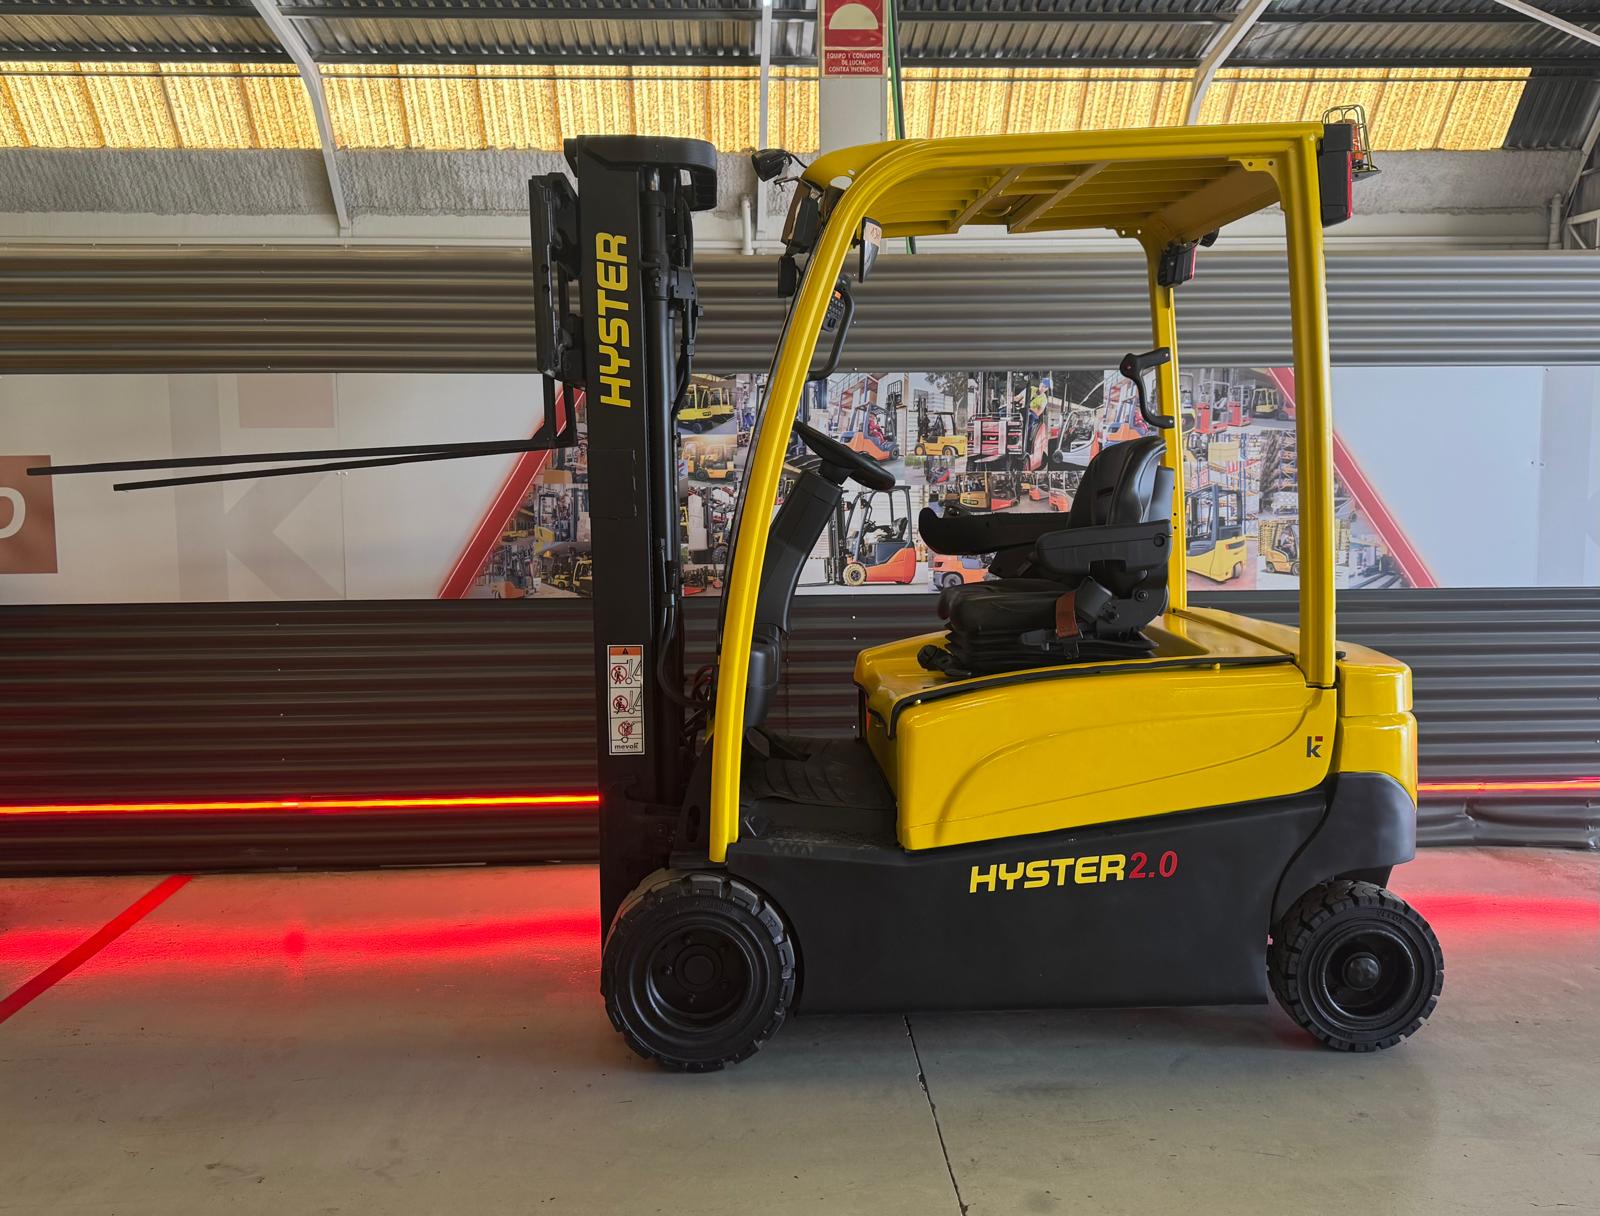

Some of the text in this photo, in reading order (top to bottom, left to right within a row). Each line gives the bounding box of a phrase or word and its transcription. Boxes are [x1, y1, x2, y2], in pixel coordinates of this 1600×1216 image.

[595, 232, 631, 408] HYSTER
[969, 850, 1179, 893] HYSTER 2.0
